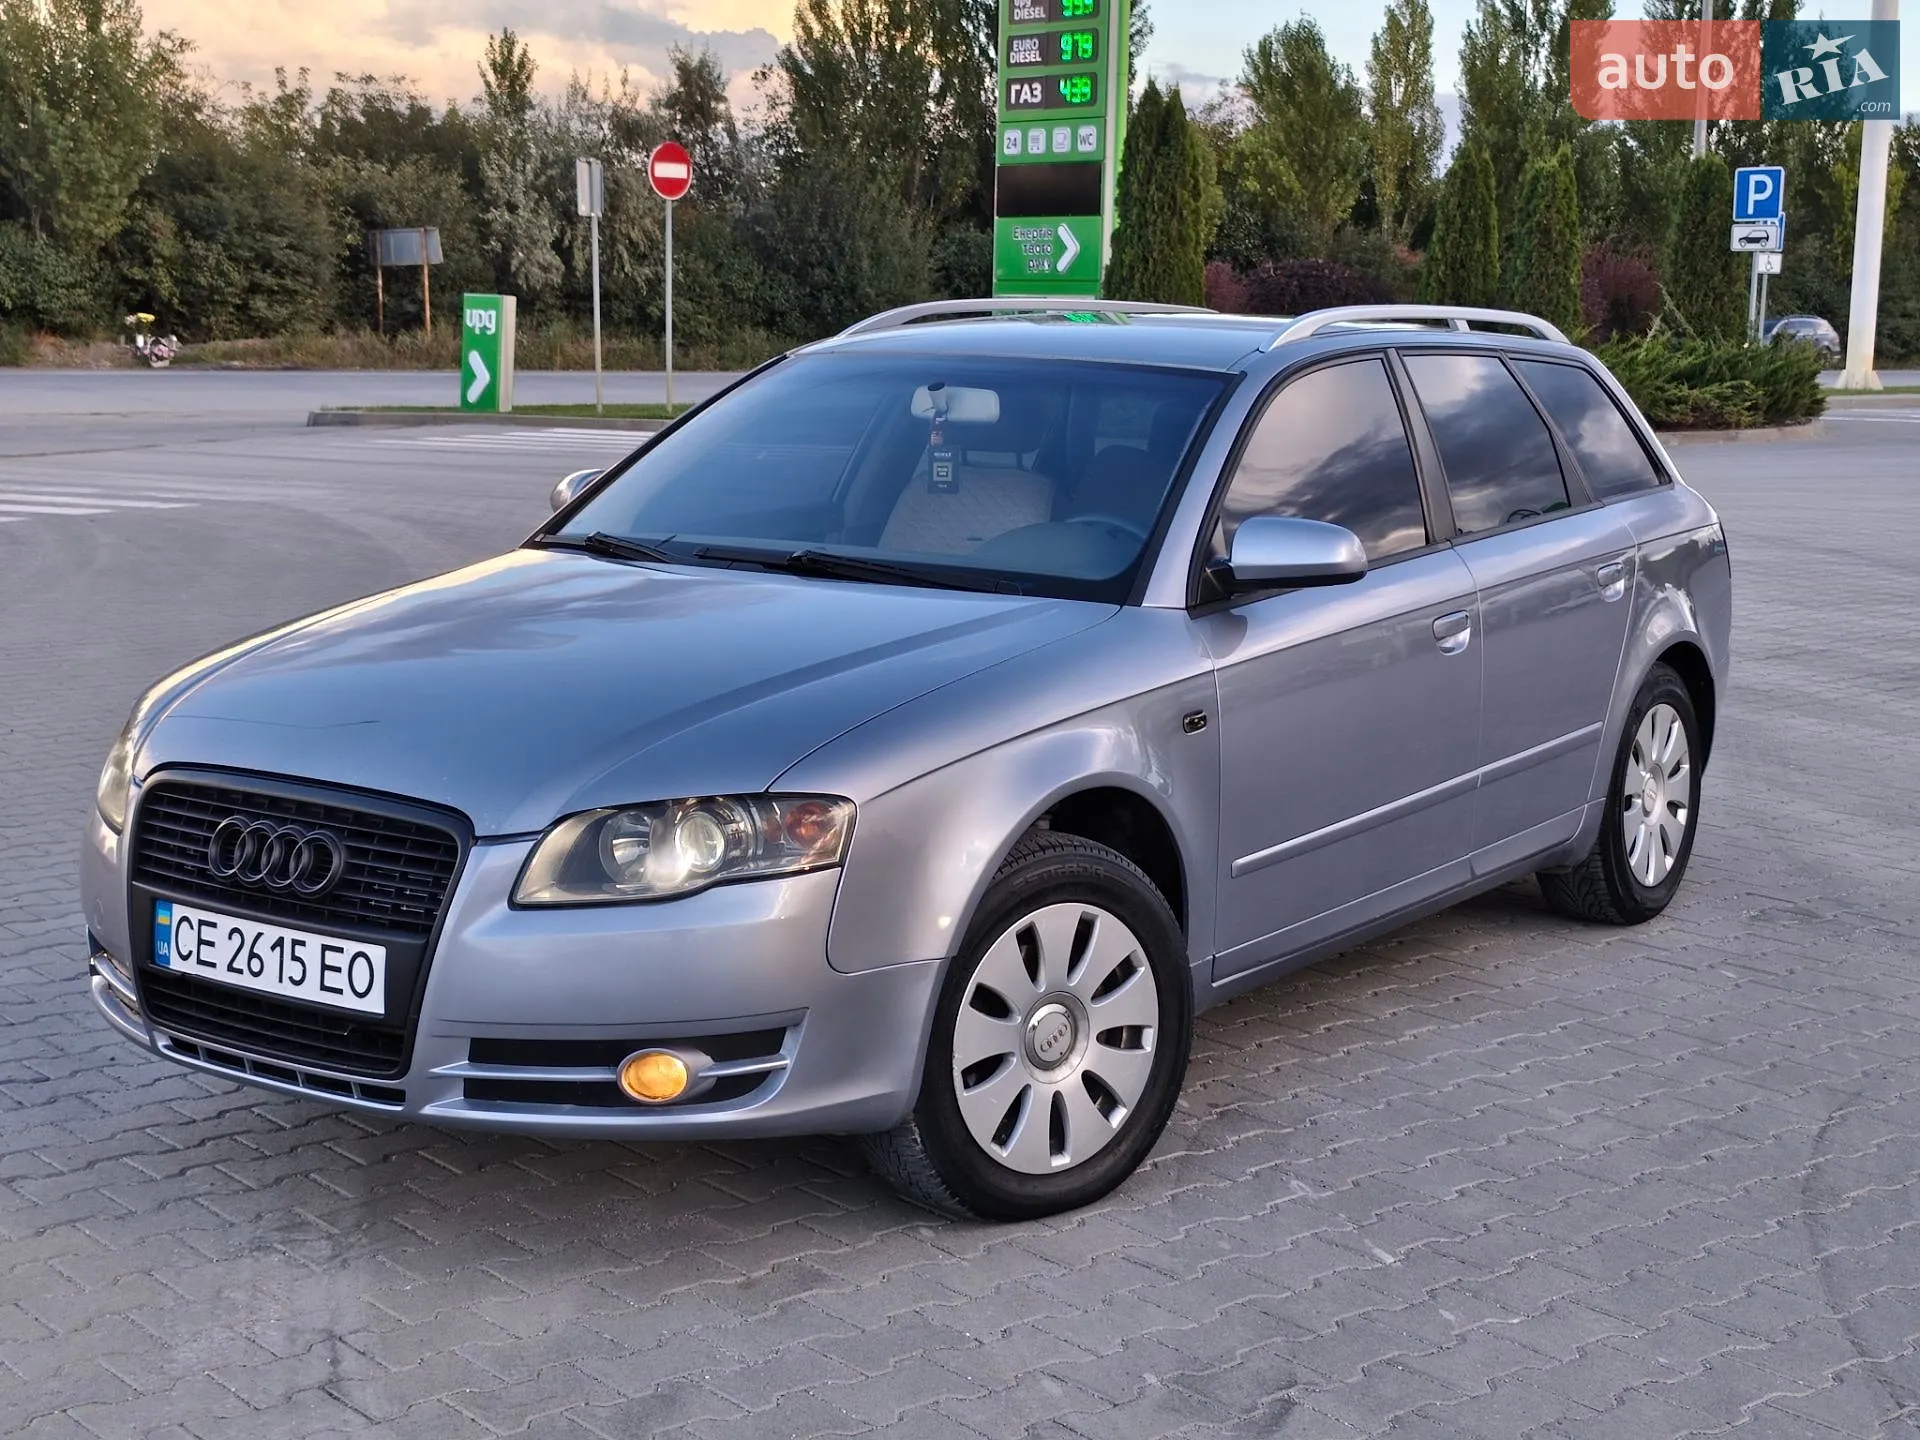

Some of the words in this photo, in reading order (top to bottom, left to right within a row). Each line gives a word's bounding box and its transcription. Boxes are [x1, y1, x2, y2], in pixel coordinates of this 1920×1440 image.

[1014, 6, 1046, 20] DIESEL
[1012, 38, 1039, 52] EURO
[1009, 50, 1042, 63] DIESEL
[1010, 82, 1042, 104] ГАЗ
[1006, 137, 1018, 149] 24
[1079, 133, 1094, 146] WC
[1747, 174, 1773, 215] P
[466, 308, 496, 335] upg
[157, 940, 169, 957] UA
[175, 915, 218, 969] CE
[226, 927, 307, 987] 2615
